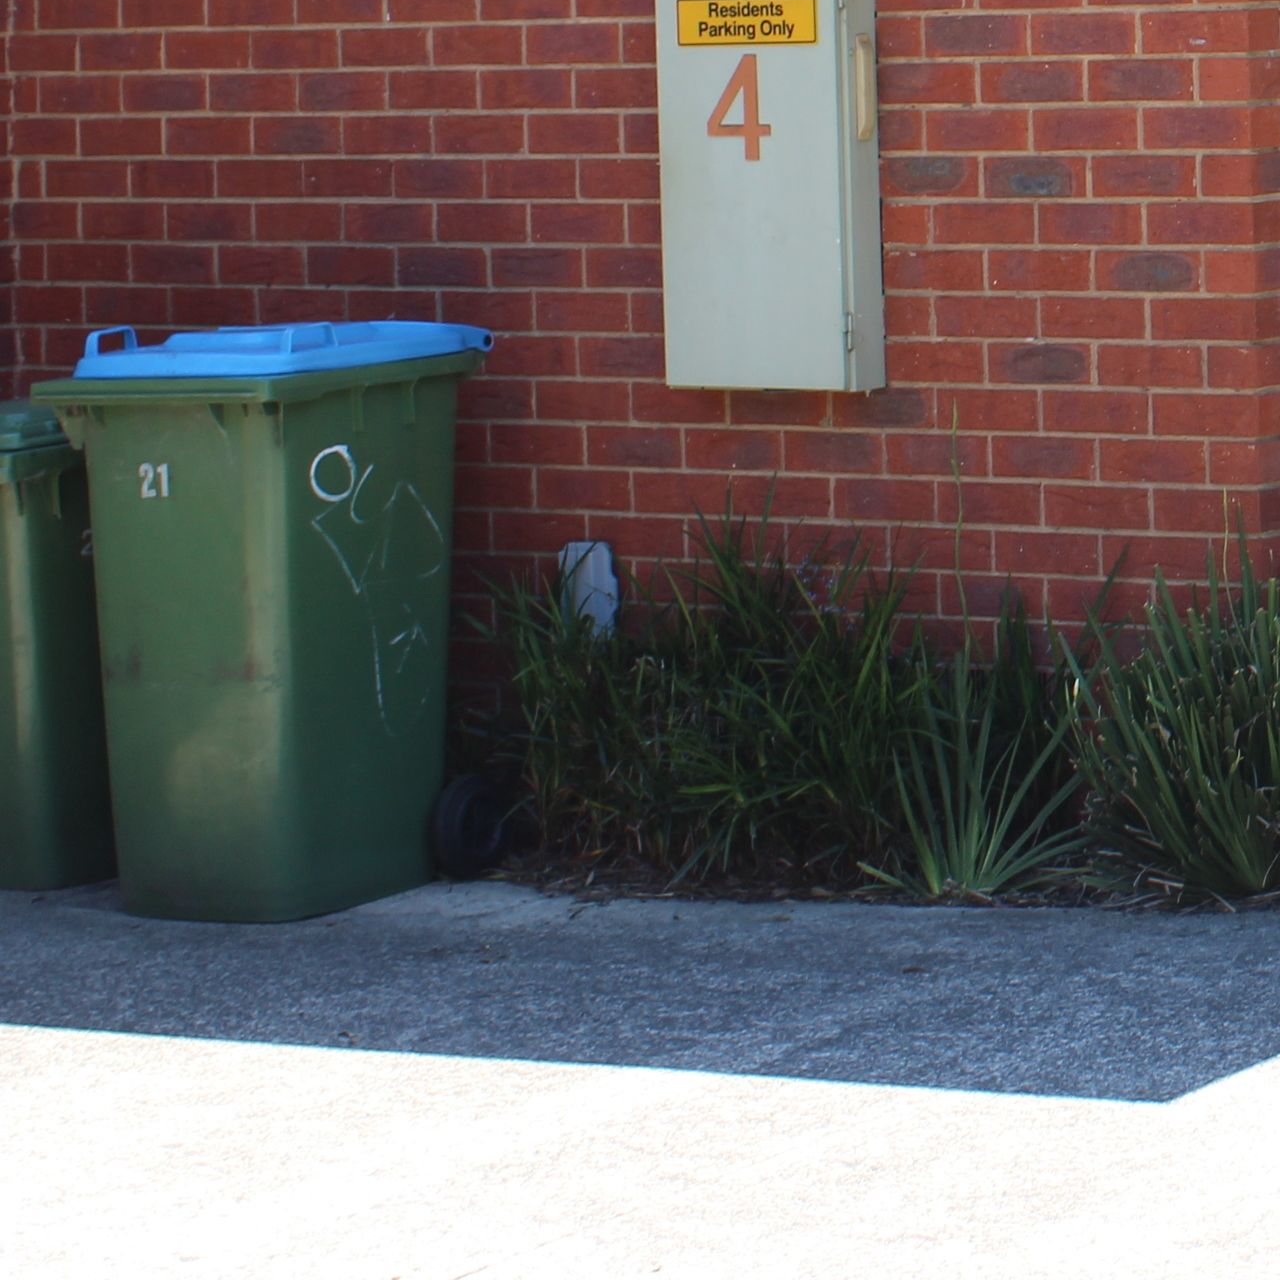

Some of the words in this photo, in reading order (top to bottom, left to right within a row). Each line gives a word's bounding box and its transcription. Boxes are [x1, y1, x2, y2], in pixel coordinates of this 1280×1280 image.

[708, 2, 784, 18] Residents
[698, 21, 756, 40] Parking
[760, 20, 795, 39] Only
[706, 53, 772, 161] 4
[138, 462, 170, 499] 21
